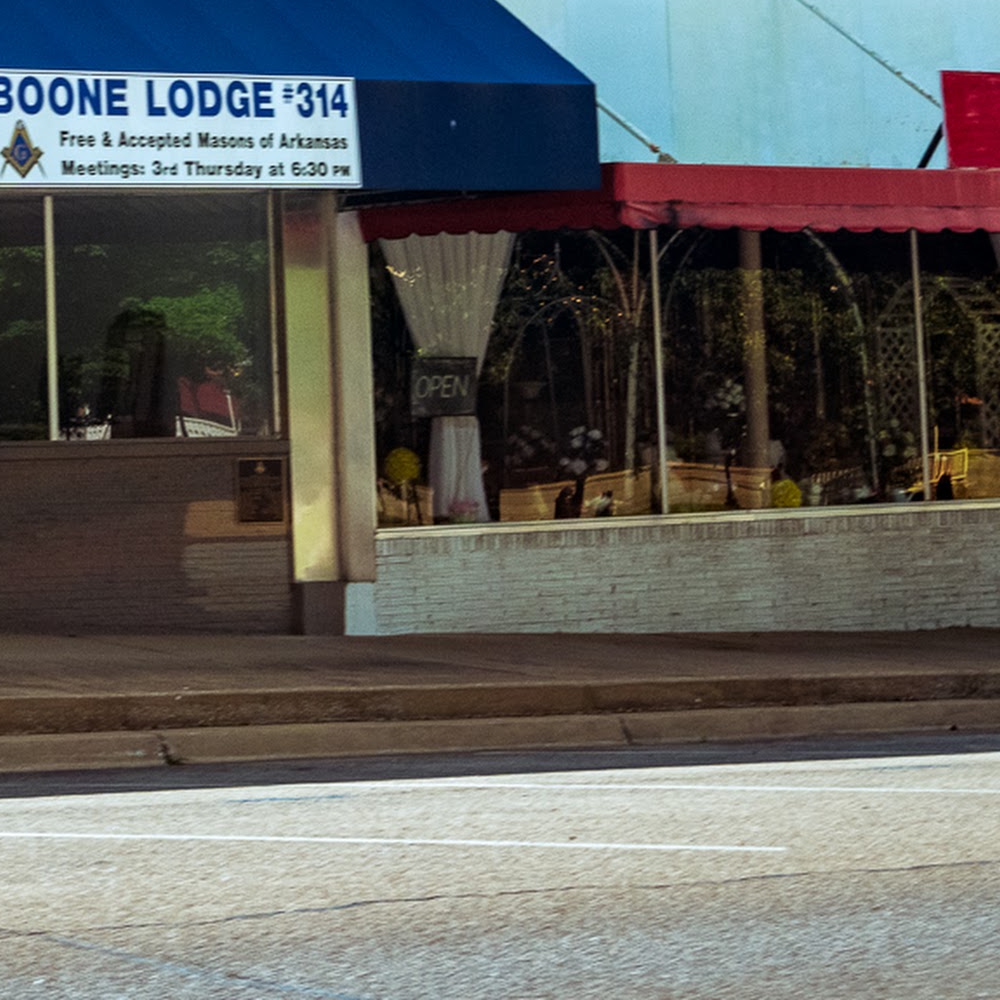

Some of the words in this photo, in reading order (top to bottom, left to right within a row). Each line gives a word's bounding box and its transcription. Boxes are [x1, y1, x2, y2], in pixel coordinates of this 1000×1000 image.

[147, 80, 275, 118] LODGE
[283, 83, 348, 118] #314
[60, 131, 95, 148] Free
[103, 132, 113, 147] &
[118, 132, 192, 151] Accepted
[198, 132, 254, 149] Masons
[260, 133, 275, 149] of
[280, 133, 348, 149] Arkansas
[62, 160, 145, 179] Meetings:
[152, 161, 178, 176] 3rd
[185, 161, 261, 179] Thursday
[269, 162, 285, 176] at
[291, 162, 327, 177] 6:30
[334, 165, 351, 177] PM
[416, 375, 470, 398] OPEN
